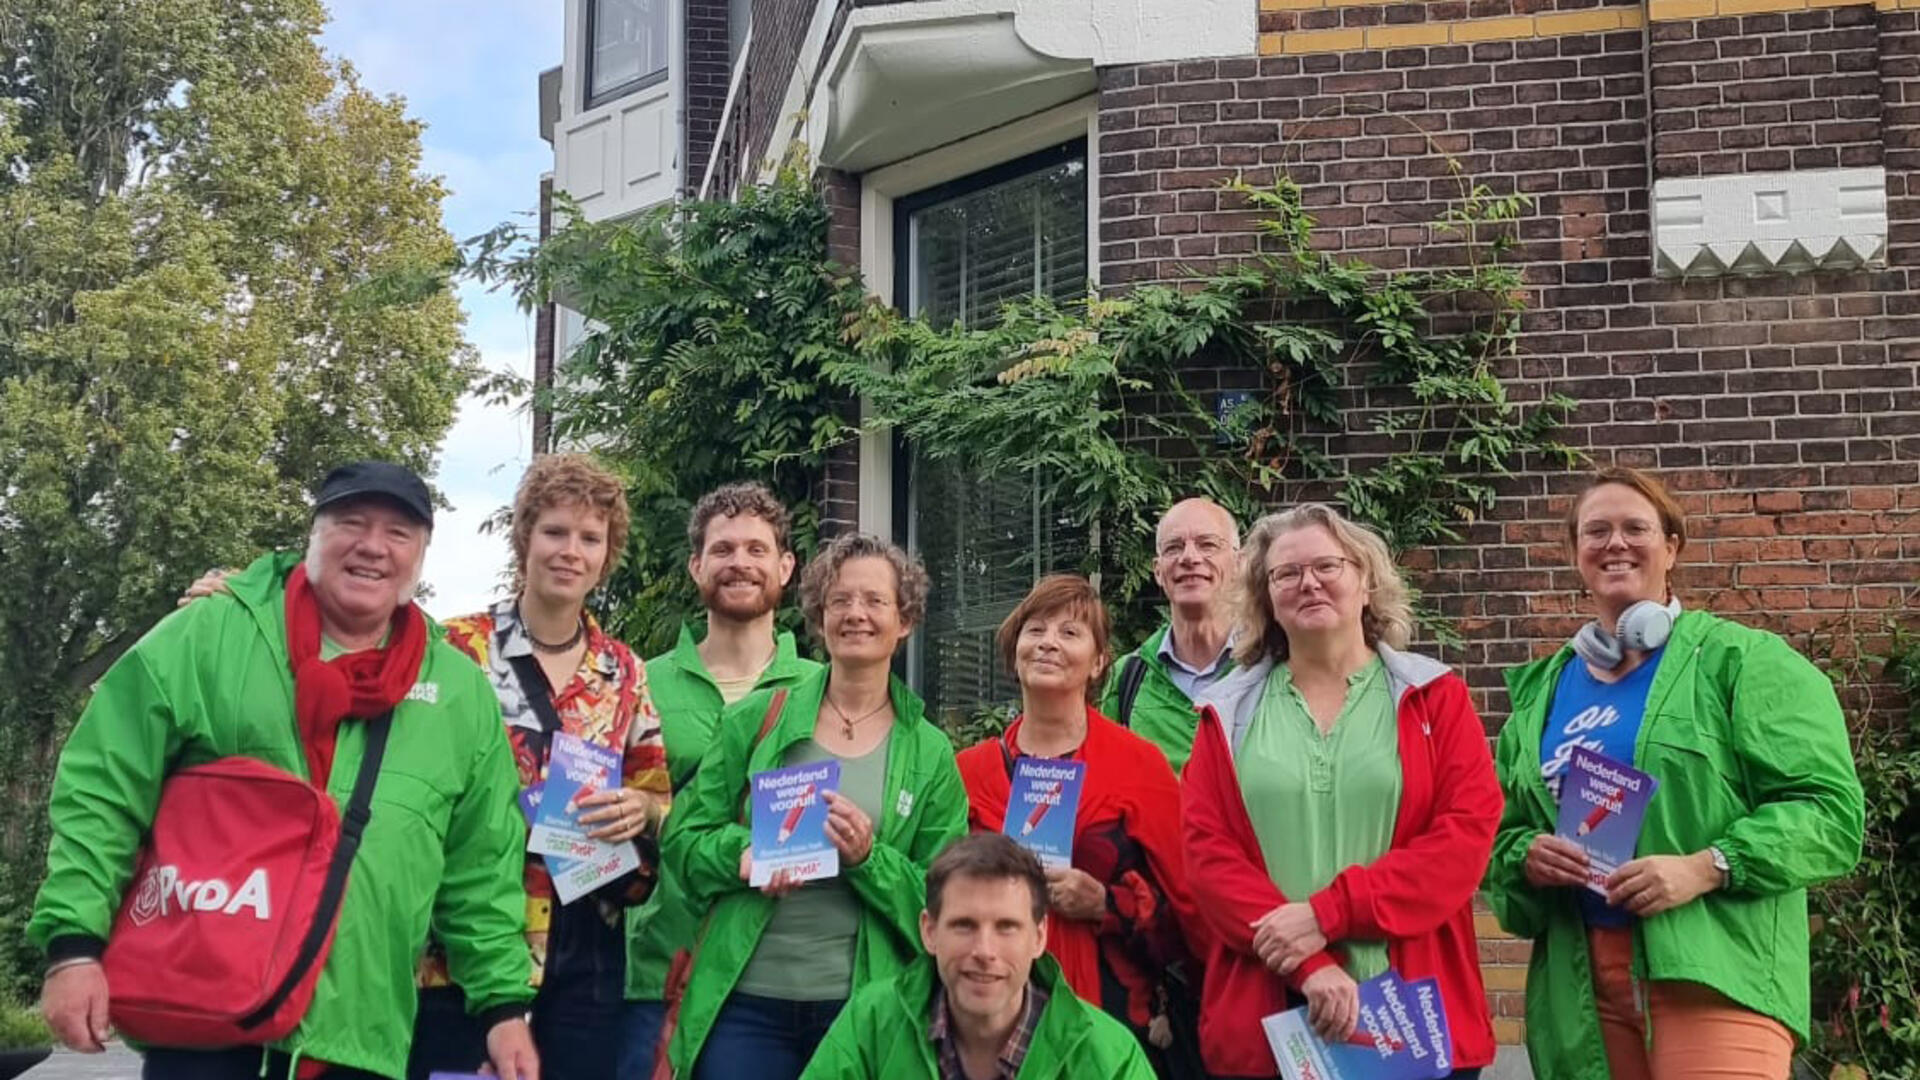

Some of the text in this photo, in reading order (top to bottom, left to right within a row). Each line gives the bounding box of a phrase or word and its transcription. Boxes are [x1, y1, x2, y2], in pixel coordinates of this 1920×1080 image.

[559, 738, 618, 769] Nederland
[566, 768, 608, 789] vooruit
[758, 767, 829, 792] Nederland
[1019, 763, 1077, 781] Nederland
[1575, 754, 1641, 792] Nederland
[776, 783, 810, 799] weer
[1023, 790, 1061, 806] vooruit
[1031, 780, 1060, 793] weer
[1588, 777, 1621, 797] weer
[769, 792, 816, 813] vooruit
[1580, 787, 1623, 815] vooruit
[1377, 1006, 1403, 1046] weer
[1380, 978, 1428, 1059] Nederland
[1417, 985, 1449, 1069] Nederland
[1361, 1004, 1393, 1059] vooruit
